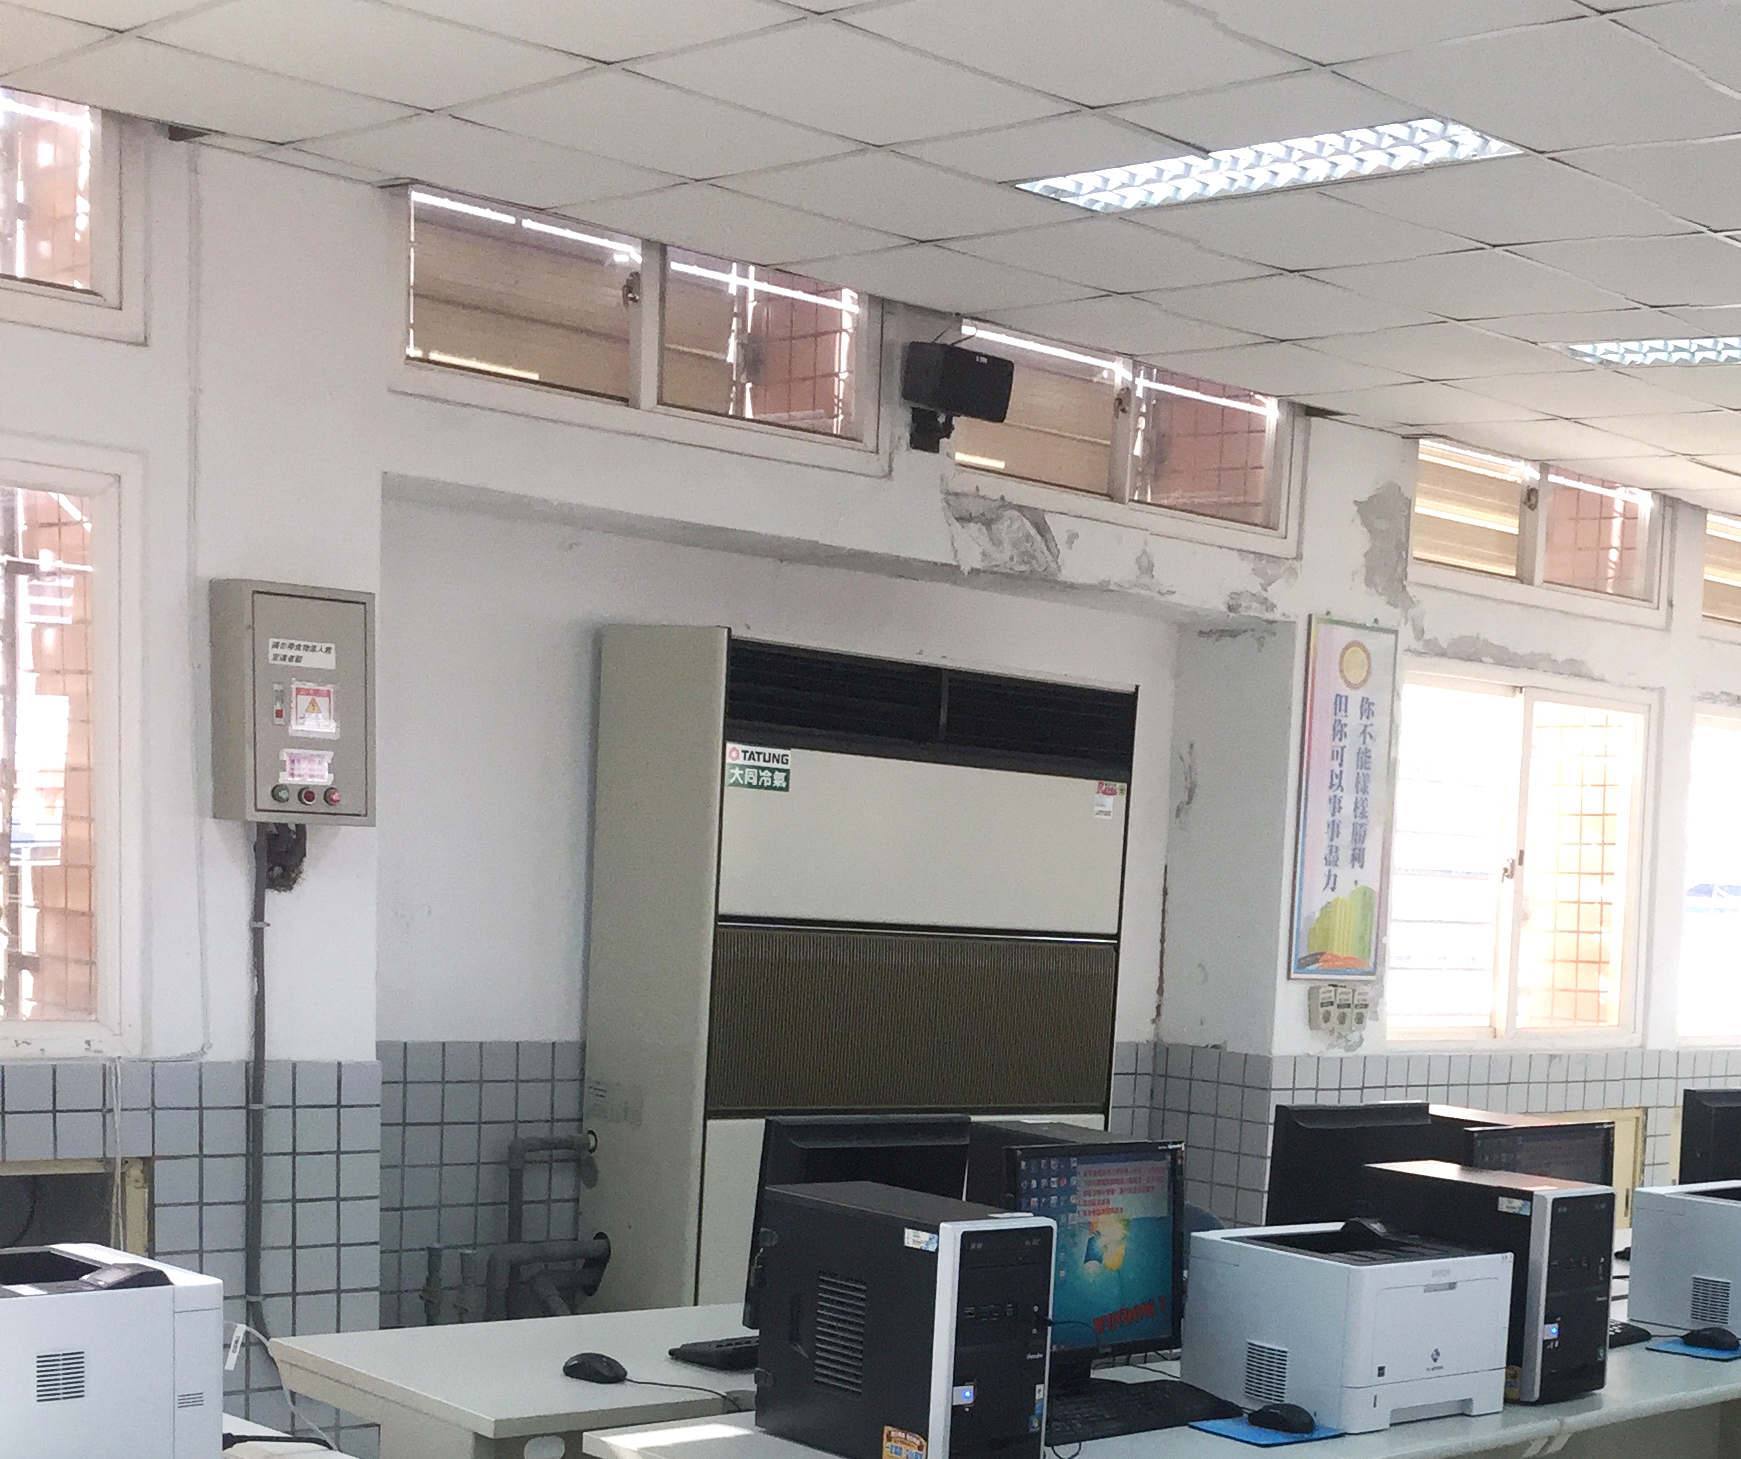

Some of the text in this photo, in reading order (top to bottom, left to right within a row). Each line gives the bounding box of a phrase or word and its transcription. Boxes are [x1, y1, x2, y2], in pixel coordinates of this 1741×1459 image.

[741, 749, 789, 765] TATUNG
[729, 766, 787, 788] 大同冷氣
